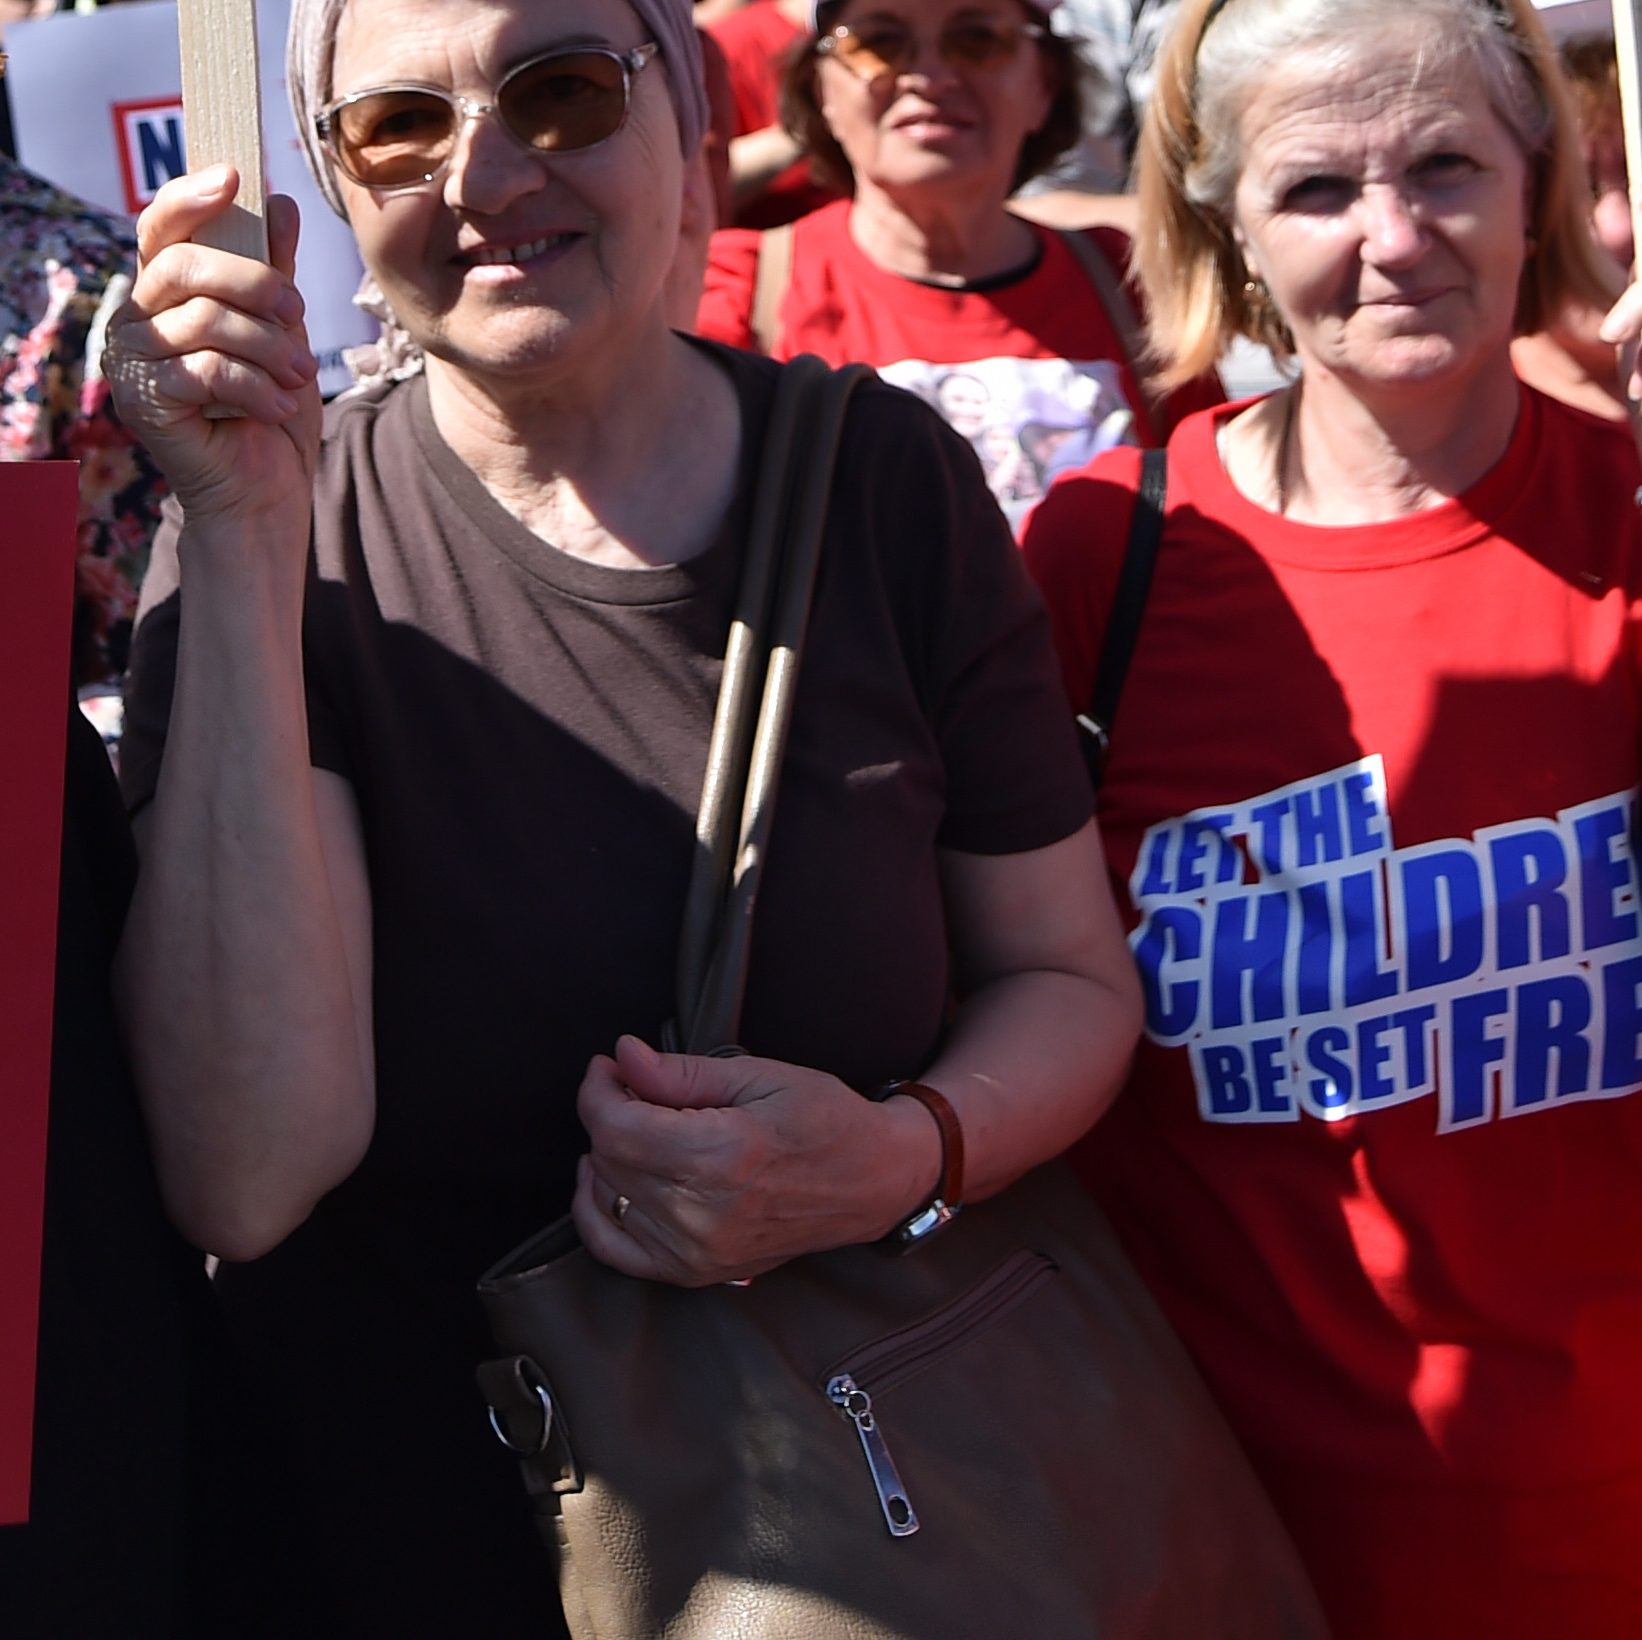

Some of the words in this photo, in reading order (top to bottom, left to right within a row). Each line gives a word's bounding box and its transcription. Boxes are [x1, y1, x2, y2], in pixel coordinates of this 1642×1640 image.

[1141, 812, 1238, 897] LET
[1249, 771, 1389, 876] THE
[1201, 1036, 1291, 1115] BE
[1305, 1002, 1436, 1109] SET
